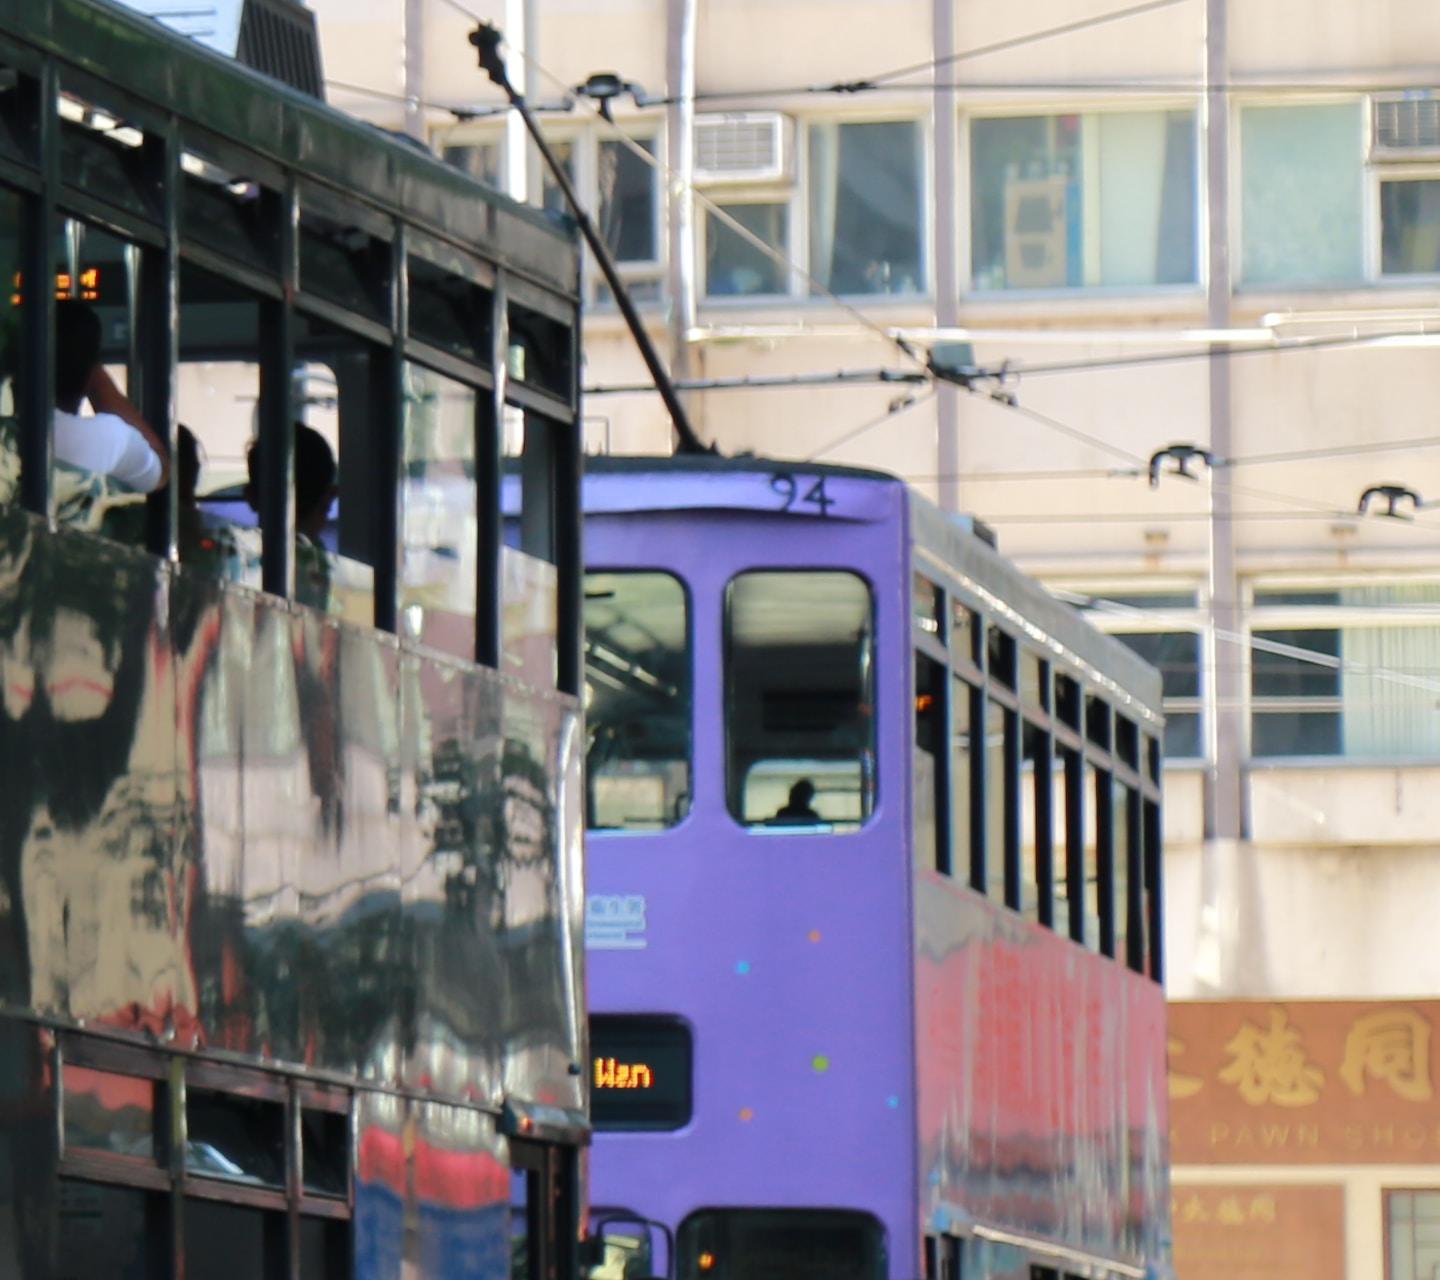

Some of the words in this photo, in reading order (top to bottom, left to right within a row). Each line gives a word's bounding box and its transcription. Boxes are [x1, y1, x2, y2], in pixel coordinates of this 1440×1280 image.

[768, 471, 837, 517] 94
[593, 1057, 653, 1089] Wan
[1210, 1121, 1321, 1148] PAWN
